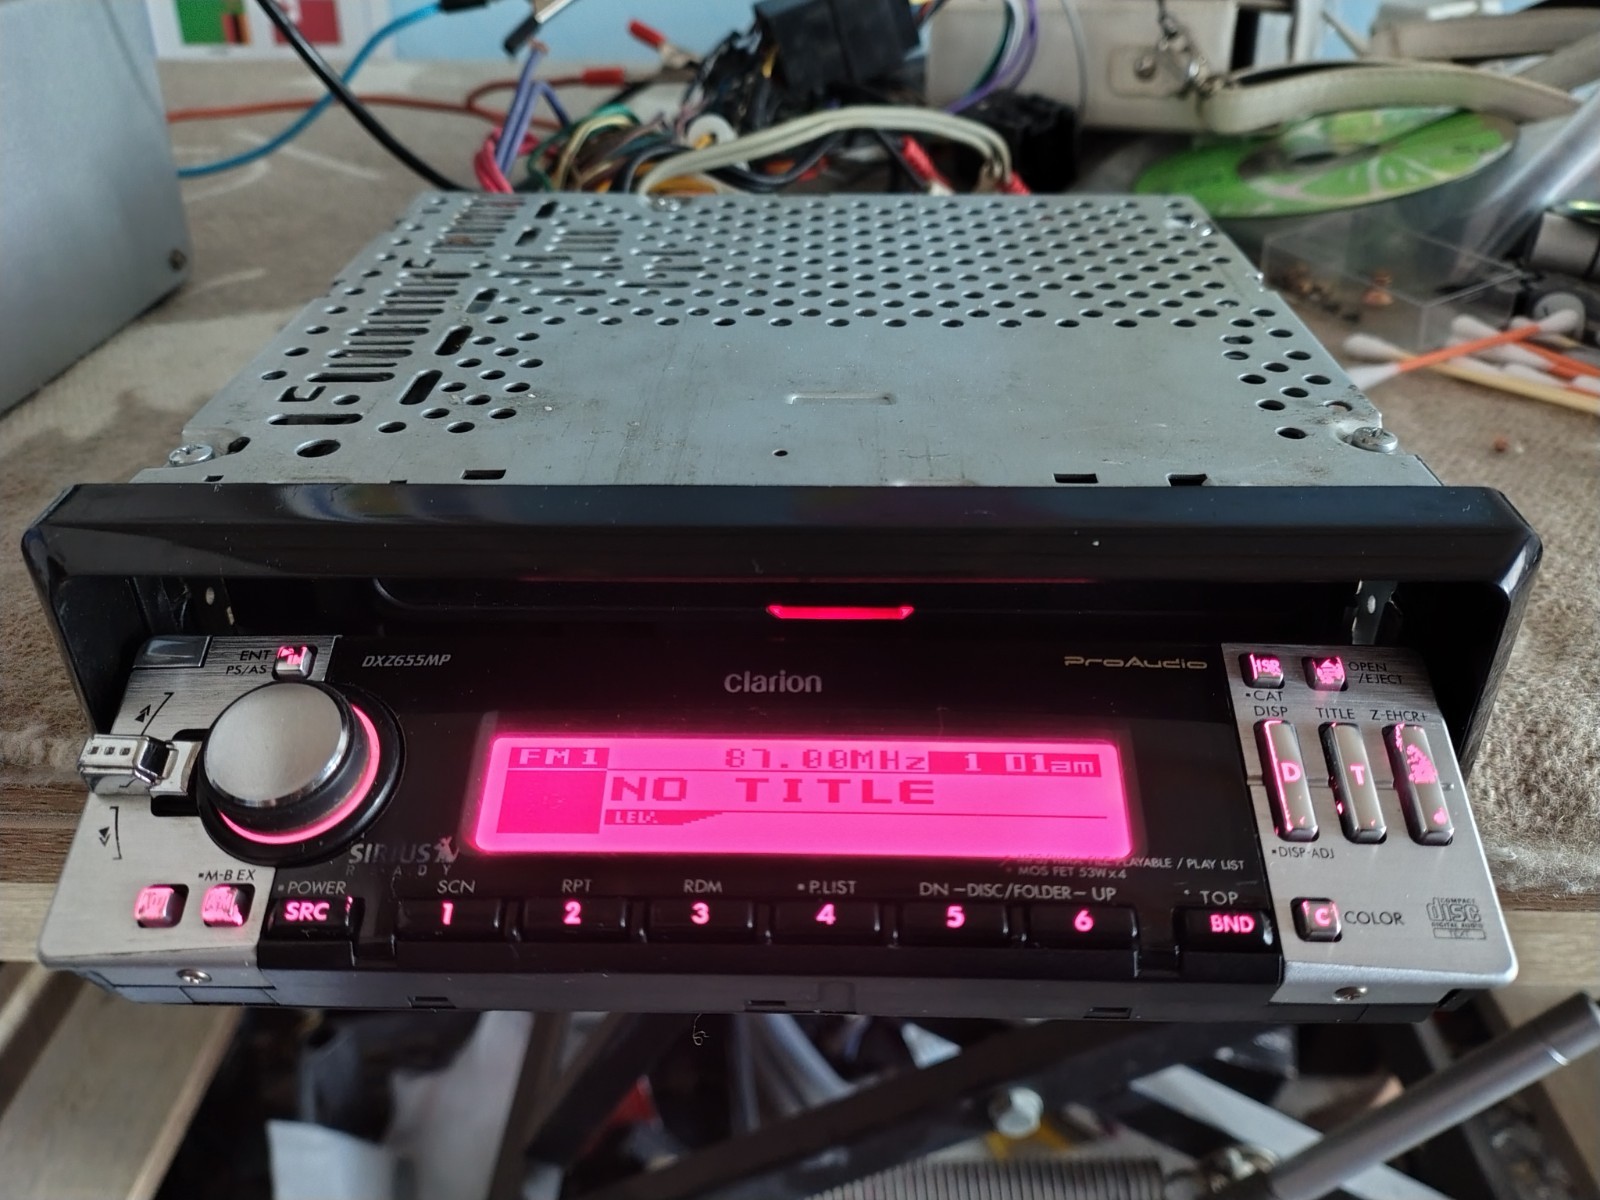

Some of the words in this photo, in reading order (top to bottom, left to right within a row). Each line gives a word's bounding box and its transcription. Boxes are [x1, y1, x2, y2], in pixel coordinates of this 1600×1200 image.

[240, 650, 271, 661] ENT
[362, 654, 452, 668] DXZ655MP
[1063, 655, 1208, 671] ProAudio
[225, 665, 267, 676] PS/AS
[1348, 662, 1388, 672] OPEN
[723, 670, 823, 693] clarion
[1253, 706, 1288, 717] DISP
[1315, 707, 1356, 719] TITLE
[1279, 762, 1302, 782] D
[1350, 764, 1366, 786] T
[610, 776, 689, 802] NO
[734, 777, 935, 805] TITLE
[1278, 846, 1335, 859] DISP-ADJ
[345, 864, 452, 877] RADY
[1018, 866, 1050, 877] MOS
[1053, 867, 1076, 877] FET
[1186, 858, 1217, 870] PLAY
[1221, 859, 1245, 870] LIST
[237, 869, 256, 880] EX
[288, 881, 347, 895] POWER
[437, 880, 477, 894] SCN
[561, 879, 592, 894] RPT
[683, 879, 723, 894] RDM
[919, 882, 949, 897] DN
[1091, 886, 1117, 901] UP
[1199, 890, 1239, 906] TOP
[284, 902, 331, 921] SRC
[441, 902, 454, 926] 1
[563, 901, 582, 925] 2
[690, 902, 710, 925] 3
[815, 903, 837, 926] 4
[946, 905, 966, 929] 5
[1314, 908, 1331, 926] C
[1344, 910, 1405, 926] COLOR
[1073, 909, 1095, 932] 6
[1209, 914, 1256, 934] BND
